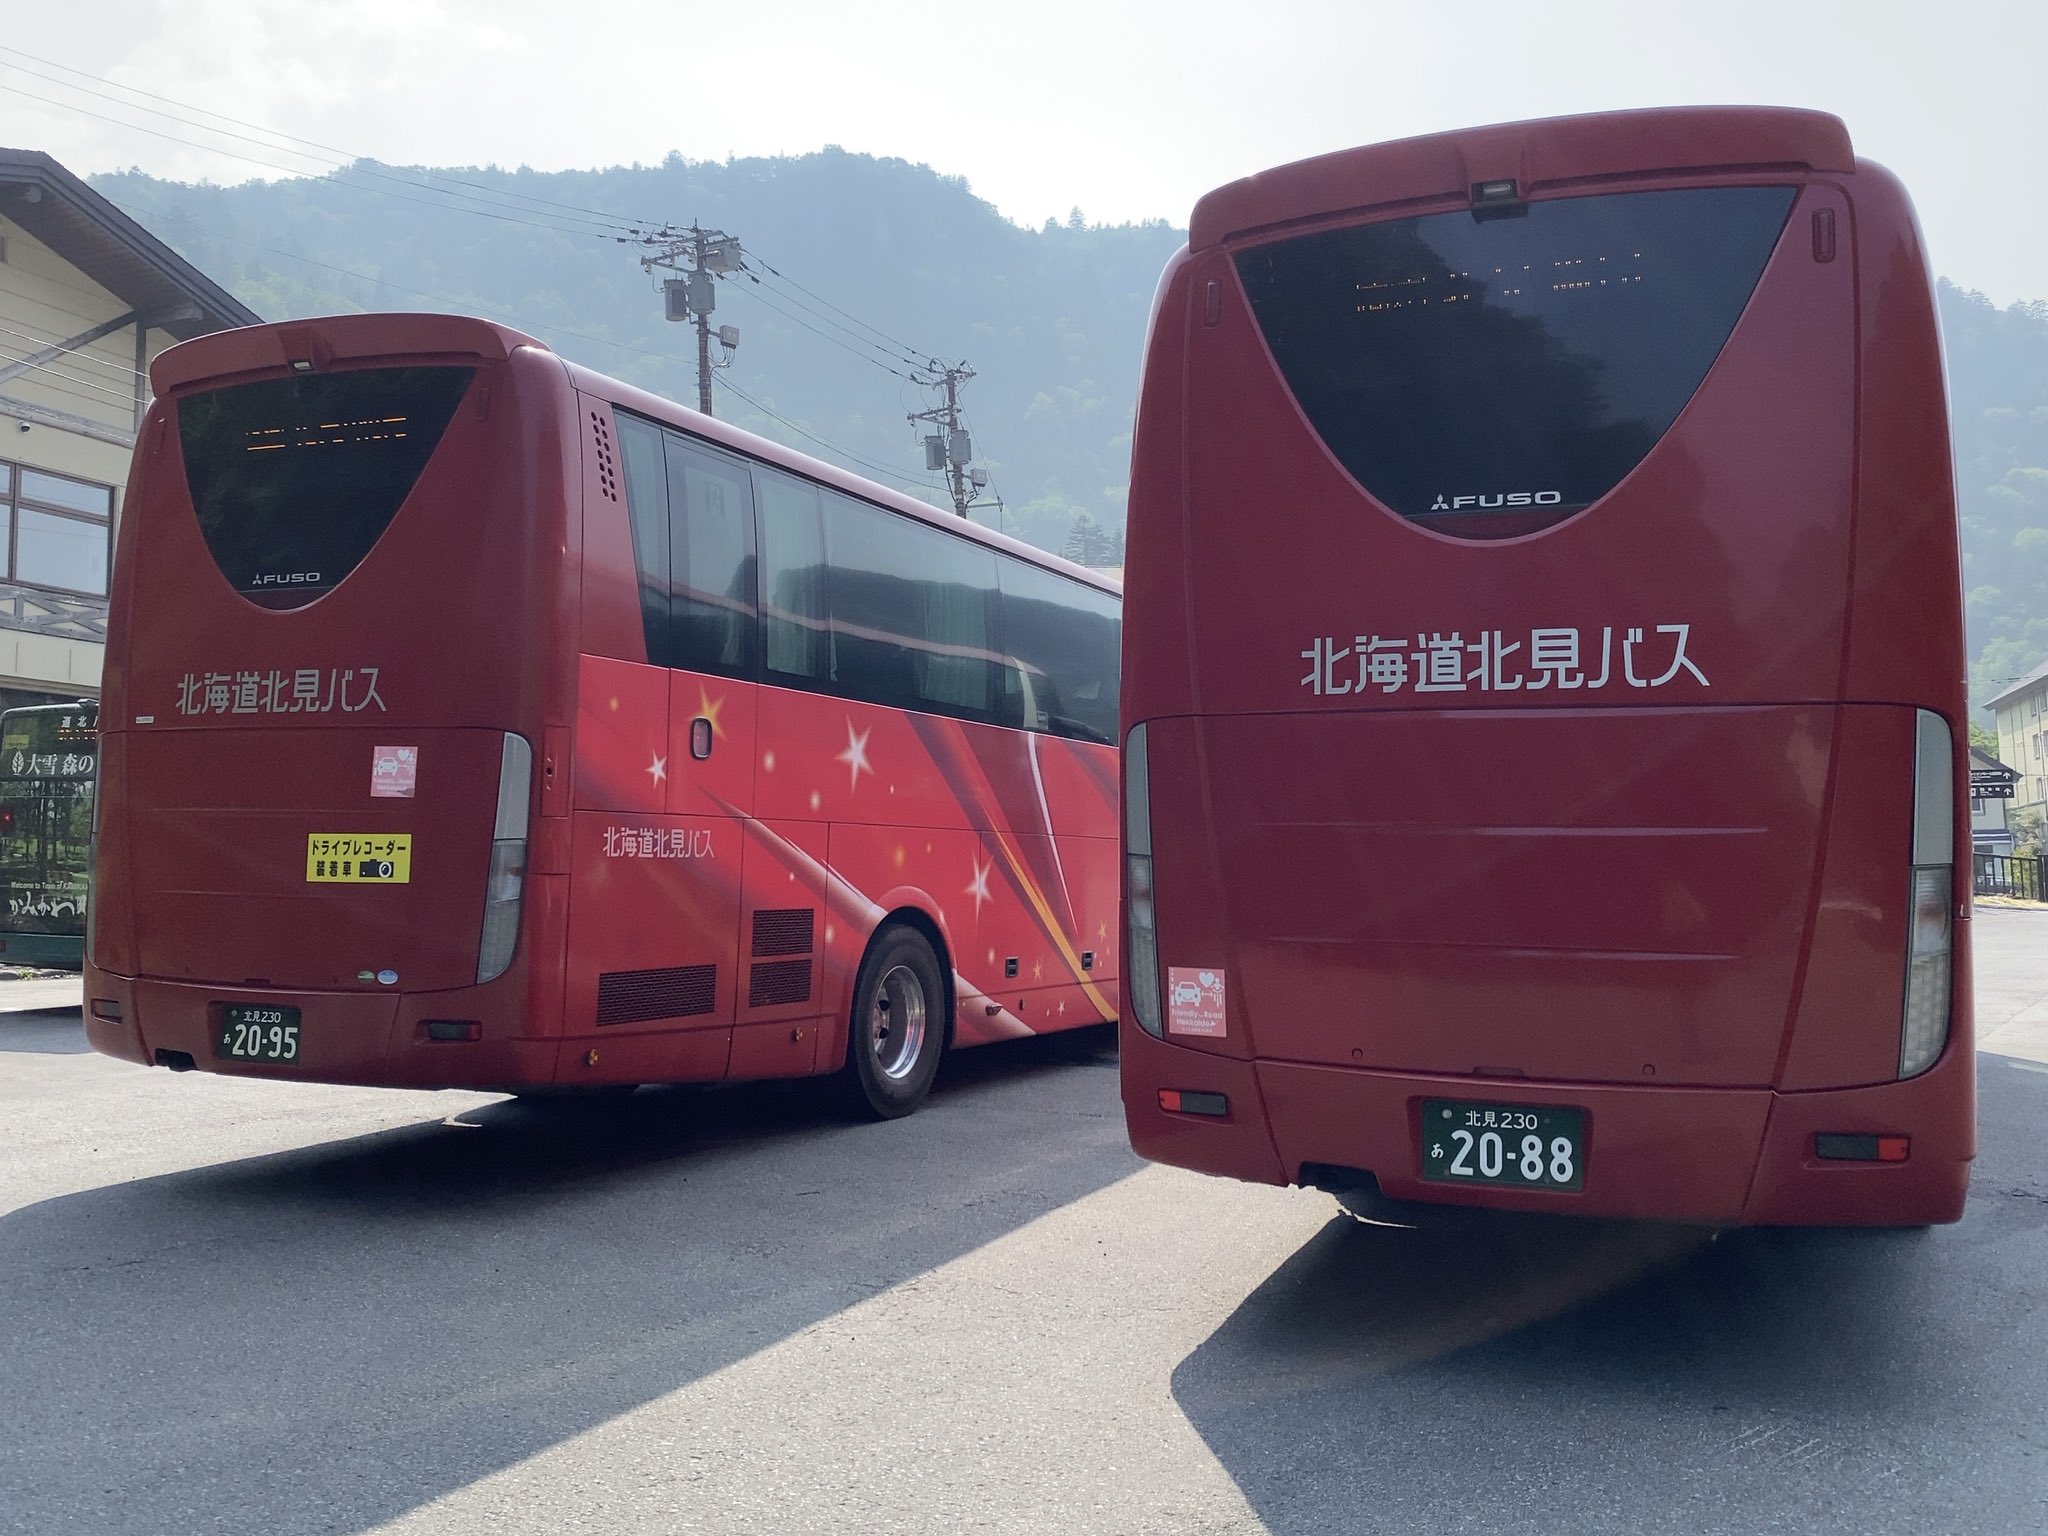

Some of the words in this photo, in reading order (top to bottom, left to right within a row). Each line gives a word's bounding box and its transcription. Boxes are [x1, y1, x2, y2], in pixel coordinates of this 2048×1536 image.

[1453, 491, 1561, 509] FUSO
[264, 573, 321, 585] FUSO
[1301, 624, 1710, 695] 北海道北見バス
[176, 668, 387, 715] 北海道北見バス
[312, 840, 406, 856] ドライブレコーダー
[602, 826, 715, 858] 北海道北見バス
[223, 1033, 231, 1044] あ
[232, 1024, 298, 1058] 20-95
[1430, 1142, 1444, 1159] あ
[1450, 1130, 1574, 1183] 20-88
